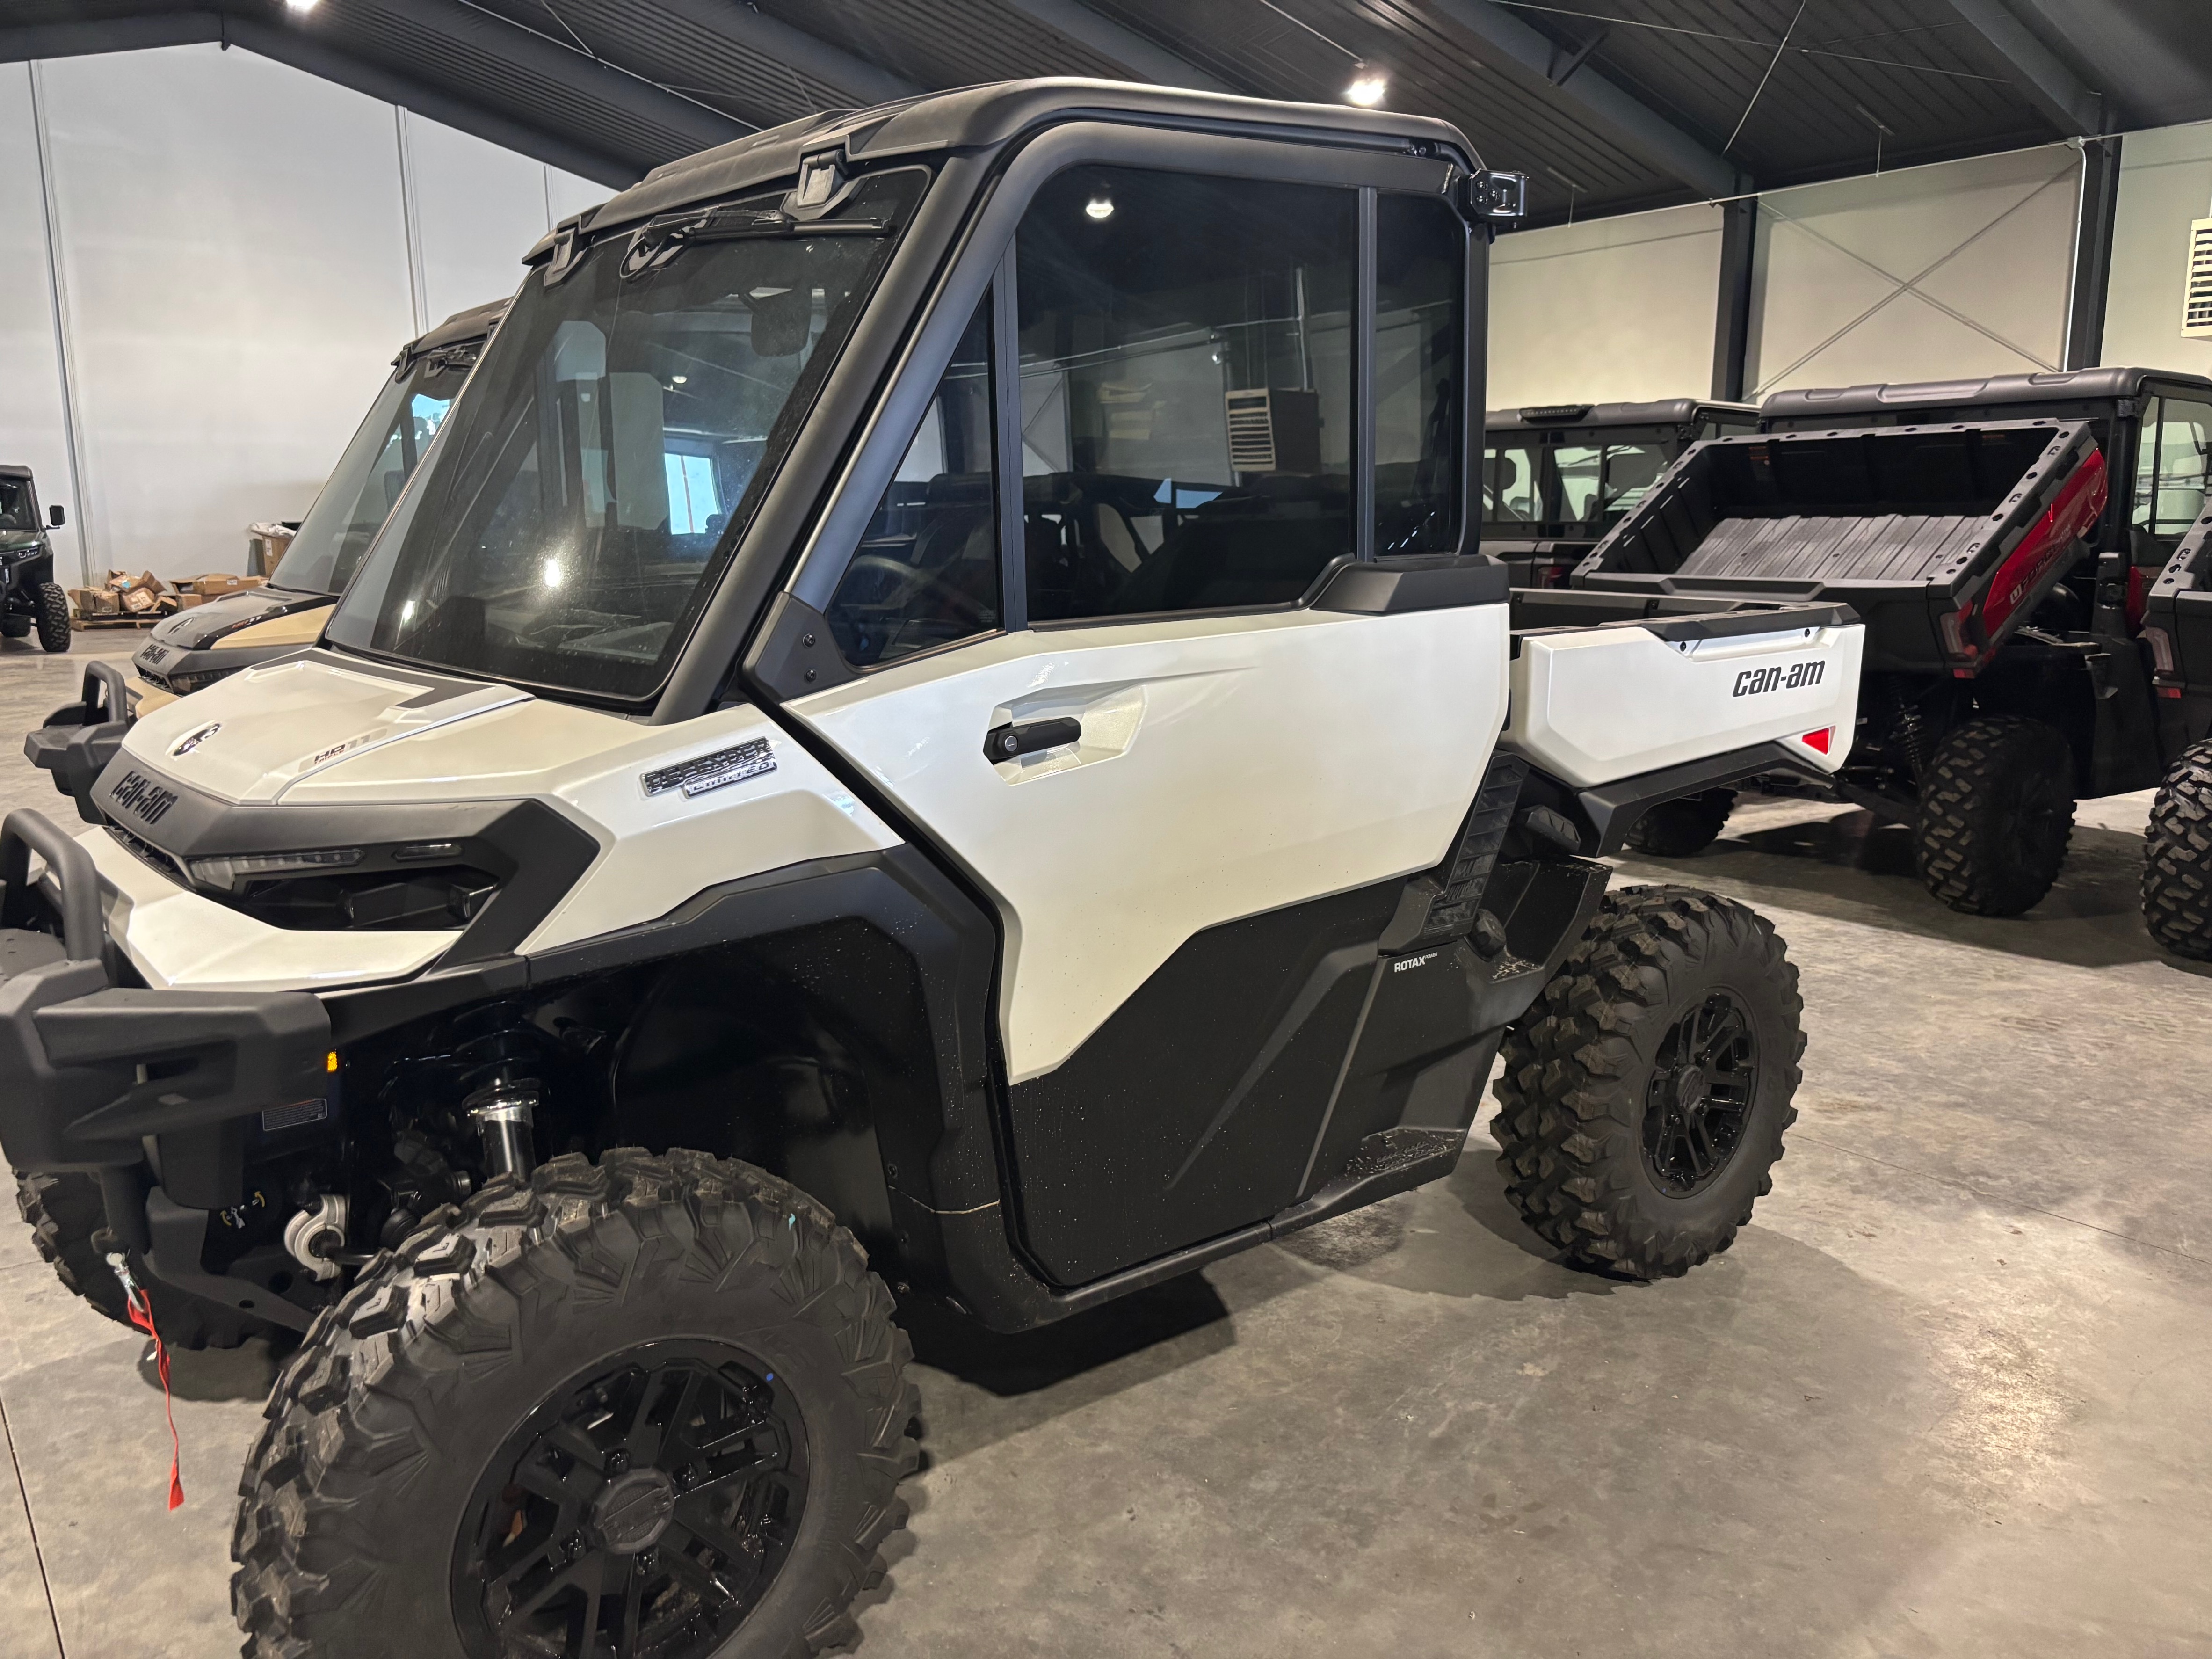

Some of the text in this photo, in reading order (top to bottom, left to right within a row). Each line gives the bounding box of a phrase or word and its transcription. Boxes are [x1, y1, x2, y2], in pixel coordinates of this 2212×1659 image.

[1732, 660, 1826, 698] can-am
[647, 740, 771, 789] DEFENDER
[110, 771, 178, 825] can-am
[1394, 955, 1426, 973] ROTAX
